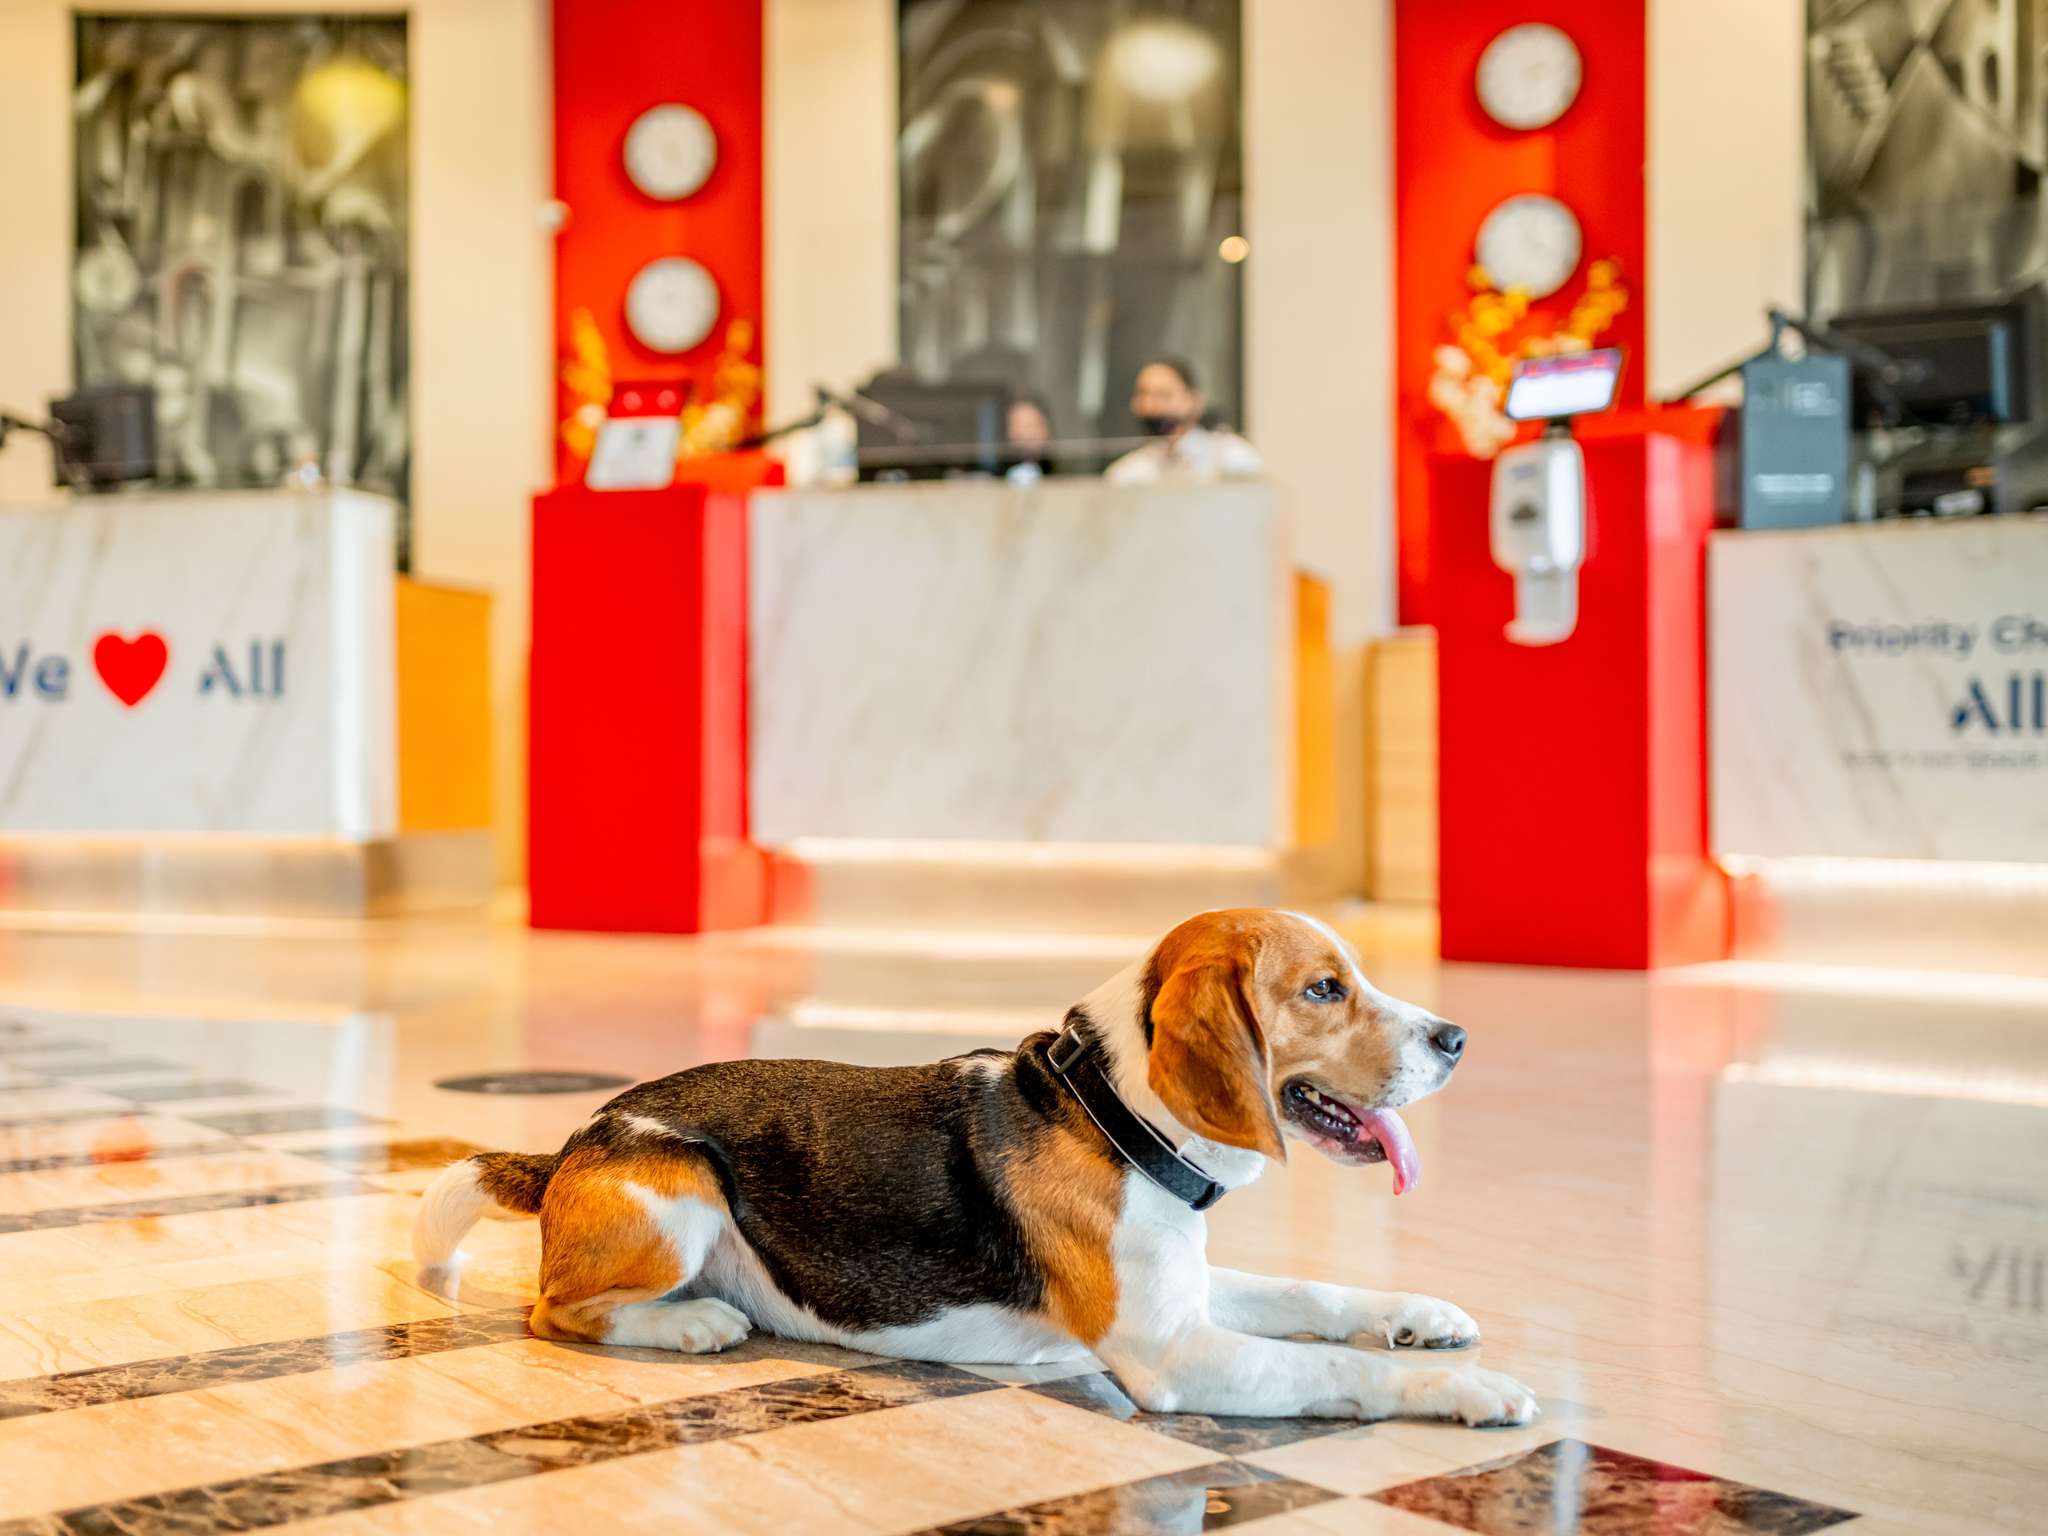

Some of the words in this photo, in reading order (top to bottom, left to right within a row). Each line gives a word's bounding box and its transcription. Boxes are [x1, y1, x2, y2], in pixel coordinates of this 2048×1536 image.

[1828, 618, 1977, 659] Priority
[198, 639, 286, 698] All
[1951, 671, 2048, 731] All
